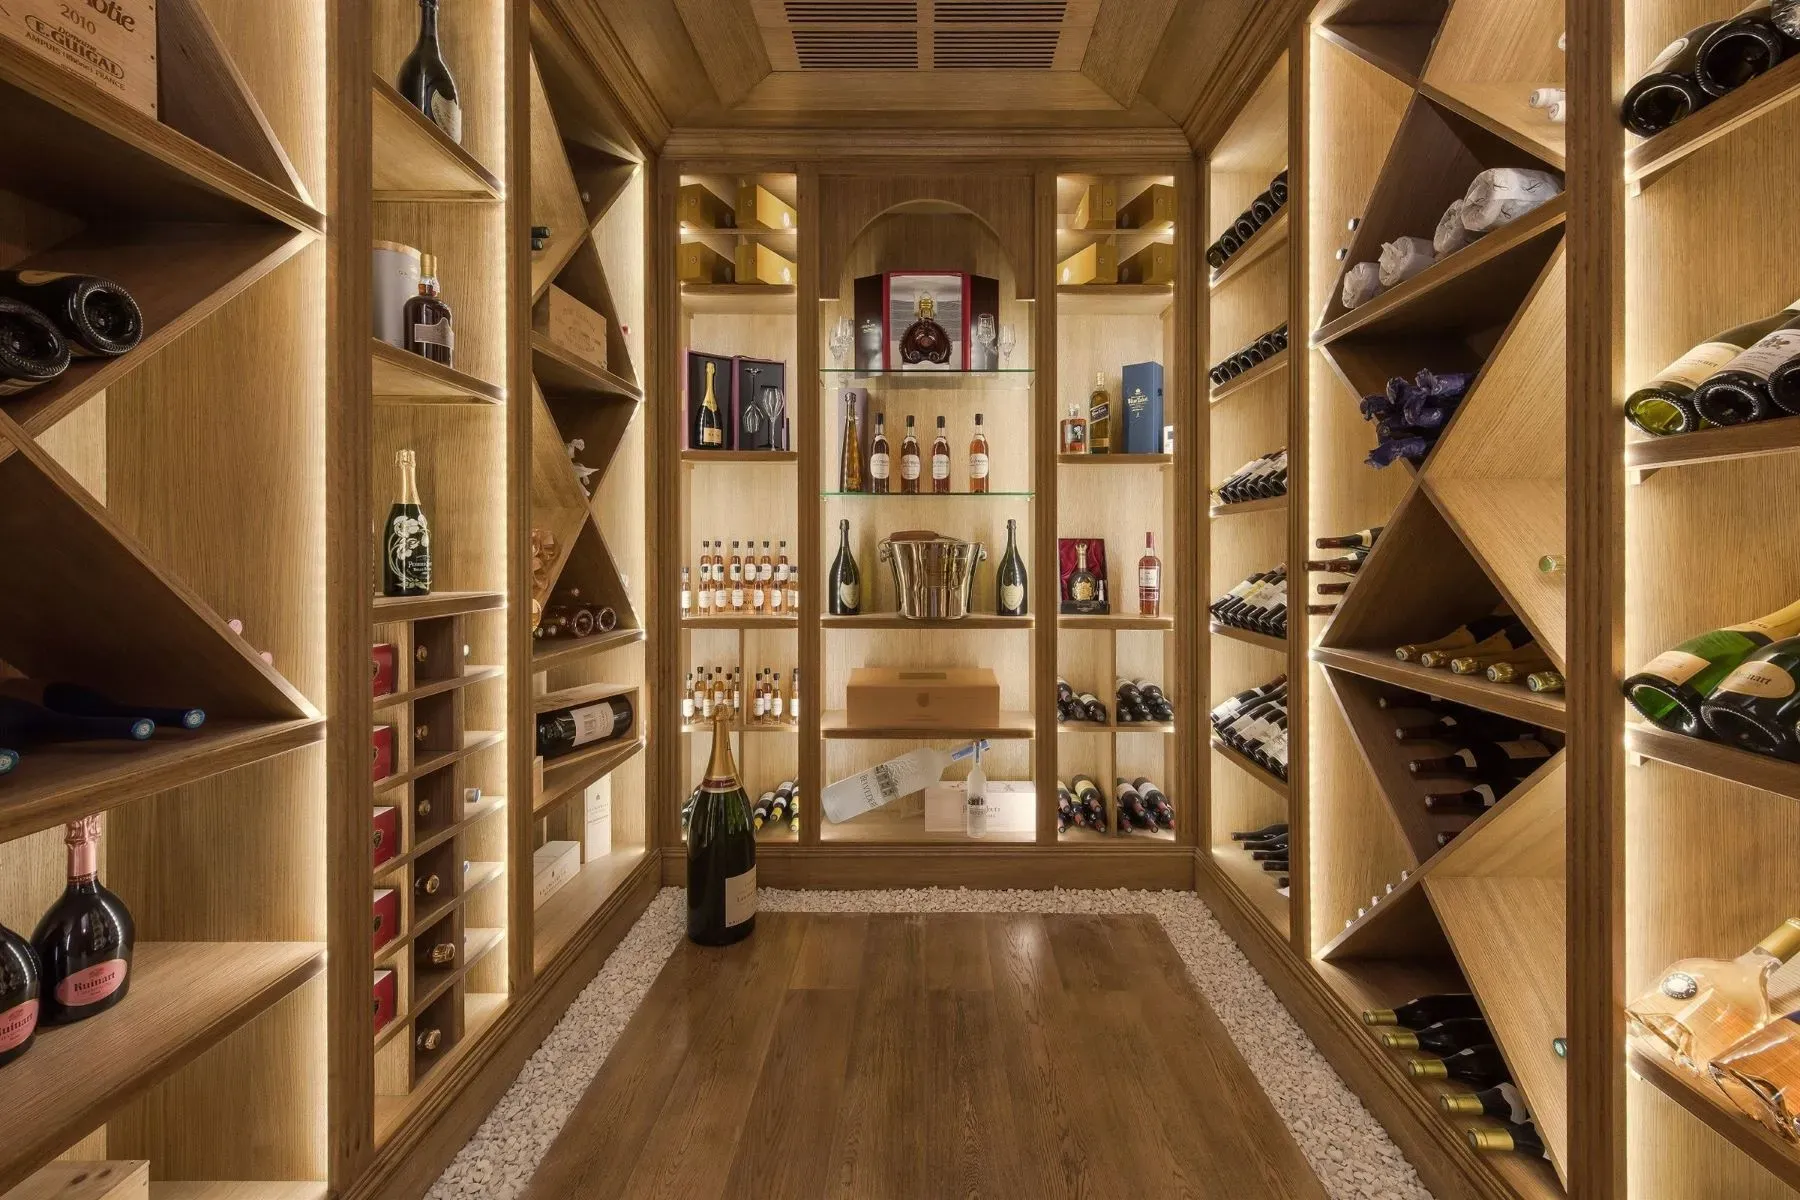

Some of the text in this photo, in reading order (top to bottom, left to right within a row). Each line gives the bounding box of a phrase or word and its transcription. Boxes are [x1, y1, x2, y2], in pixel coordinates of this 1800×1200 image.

[59, 4, 97, 35] 2010
[25, 31, 61, 56] AMPUIS
[95, 71, 127, 91] FRANCE
[35, 20, 119, 77] E.GUIGAL
[74, 971, 116, 993] Ruinart
